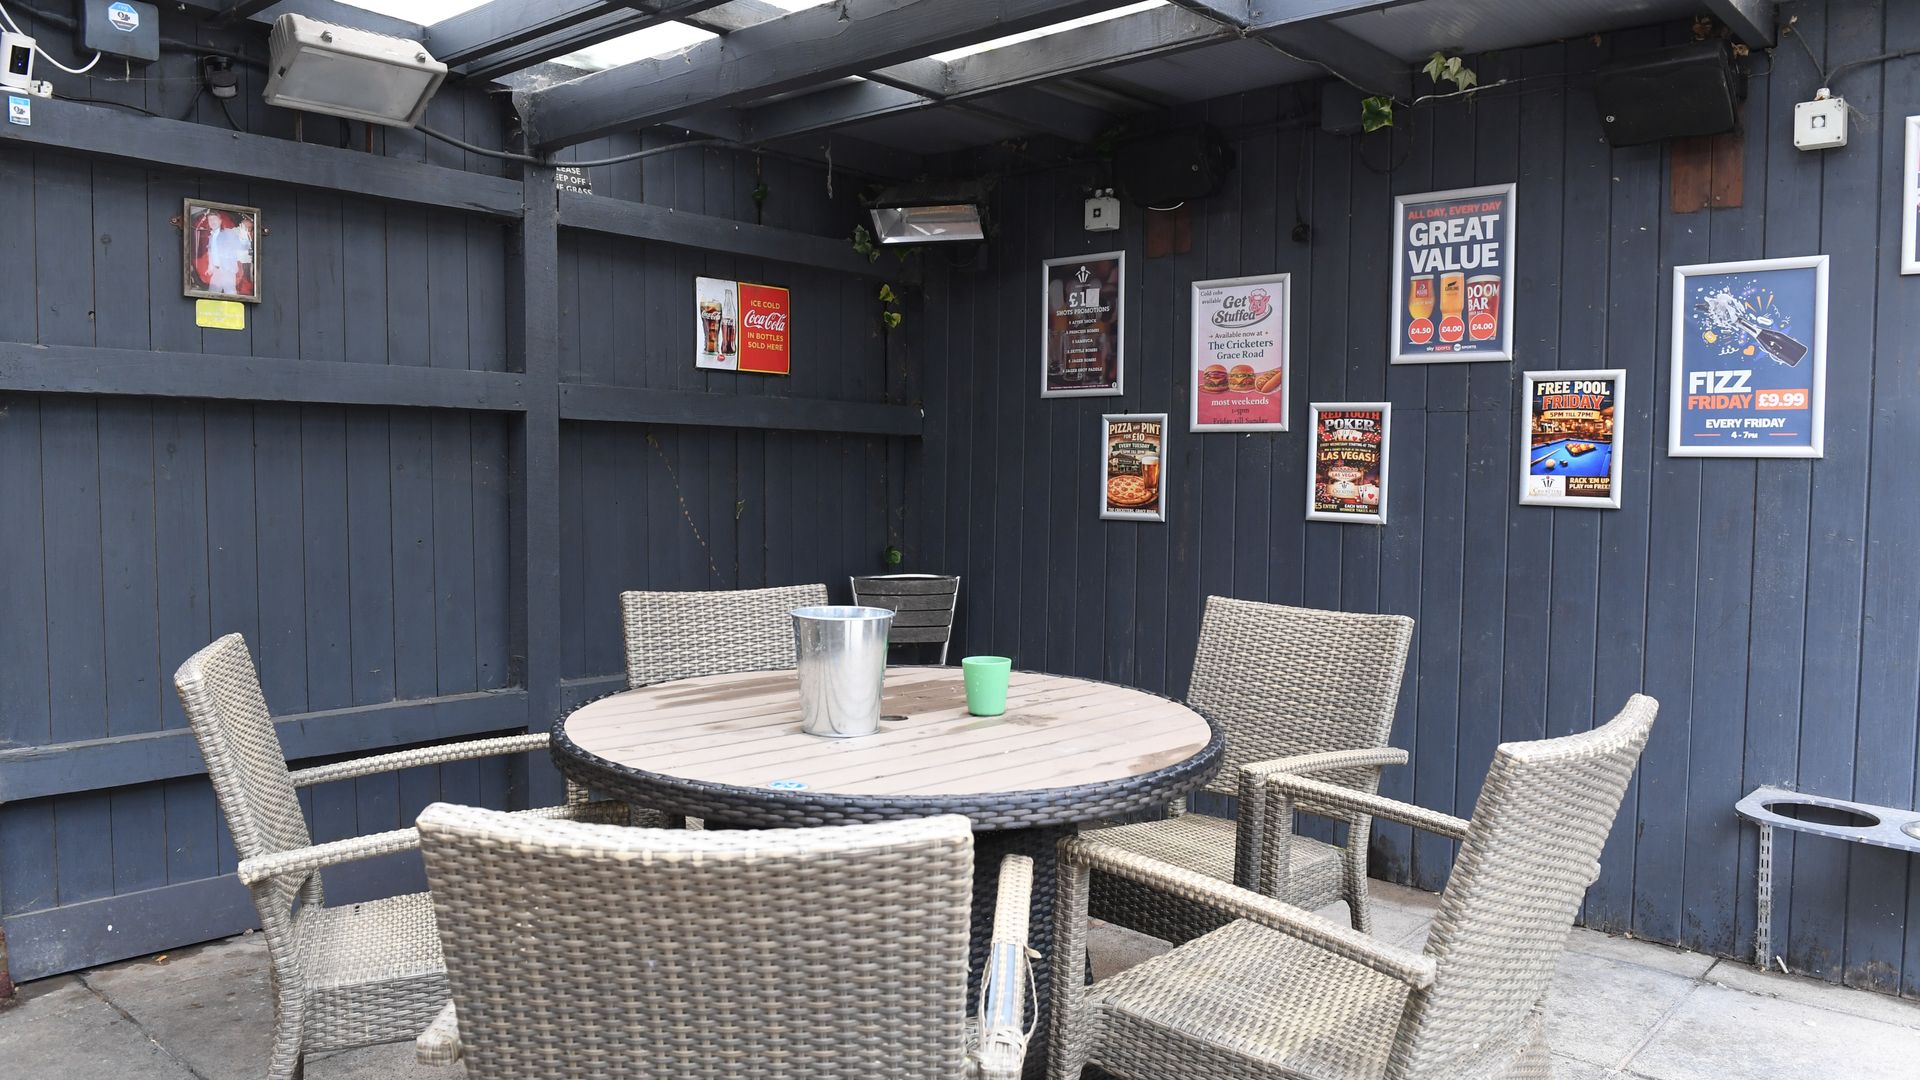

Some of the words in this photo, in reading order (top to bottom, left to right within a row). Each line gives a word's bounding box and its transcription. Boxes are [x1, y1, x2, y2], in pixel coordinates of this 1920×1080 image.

[556, 167, 581, 175] LEASE
[556, 174, 569, 182] EEP
[570, 176, 586, 185] OFF
[1408, 209, 1425, 220] ALL
[1427, 207, 1448, 218] DAY,
[1450, 204, 1480, 216] EVERY
[1482, 200, 1502, 212] DAY
[1409, 214, 1500, 247] GREAT
[1408, 242, 1499, 274] VALUE
[1467, 283, 1500, 299] DOOM
[751, 300, 761, 308] ICE
[763, 301, 780, 310] COLD
[1222, 295, 1247, 309] Get
[1468, 297, 1489, 312] BAR
[1056, 309, 1073, 317] SHOTS
[1074, 306, 1110, 315] PROMOTIONS
[1411, 327, 1431, 335] £4.50
[1441, 325, 1462, 333] £4.00
[1472, 323, 1493, 331] £4.00
[755, 333, 784, 342] BOTTLES
[1214, 331, 1241, 339] Available
[747, 341, 766, 350] SOLD
[766, 343, 784, 351] HERE
[1208, 341, 1225, 351] The
[1226, 338, 1273, 350] Cricketers
[1216, 350, 1241, 360] Grace
[1242, 349, 1264, 359] Road
[1689, 369, 1752, 395] FIZZ
[1537, 381, 1571, 395] FREE
[1574, 381, 1610, 395] POOL
[1211, 398, 1230, 406] most
[1231, 396, 1269, 405] weekends
[1542, 394, 1605, 410] FRIDAY
[1687, 394, 1753, 411] FRIDAY
[1758, 392, 1805, 408] £9.99
[1109, 422, 1132, 435] PIZZA
[1141, 422, 1161, 435] PINT
[1324, 418, 1375, 432] POKER
[1705, 418, 1743, 429] EVERY
[1743, 417, 1786, 428] FRIDAY
[1132, 432, 1145, 441] £10
[1321, 451, 1339, 461] LAS
[1341, 451, 1376, 462] VEGAS!
